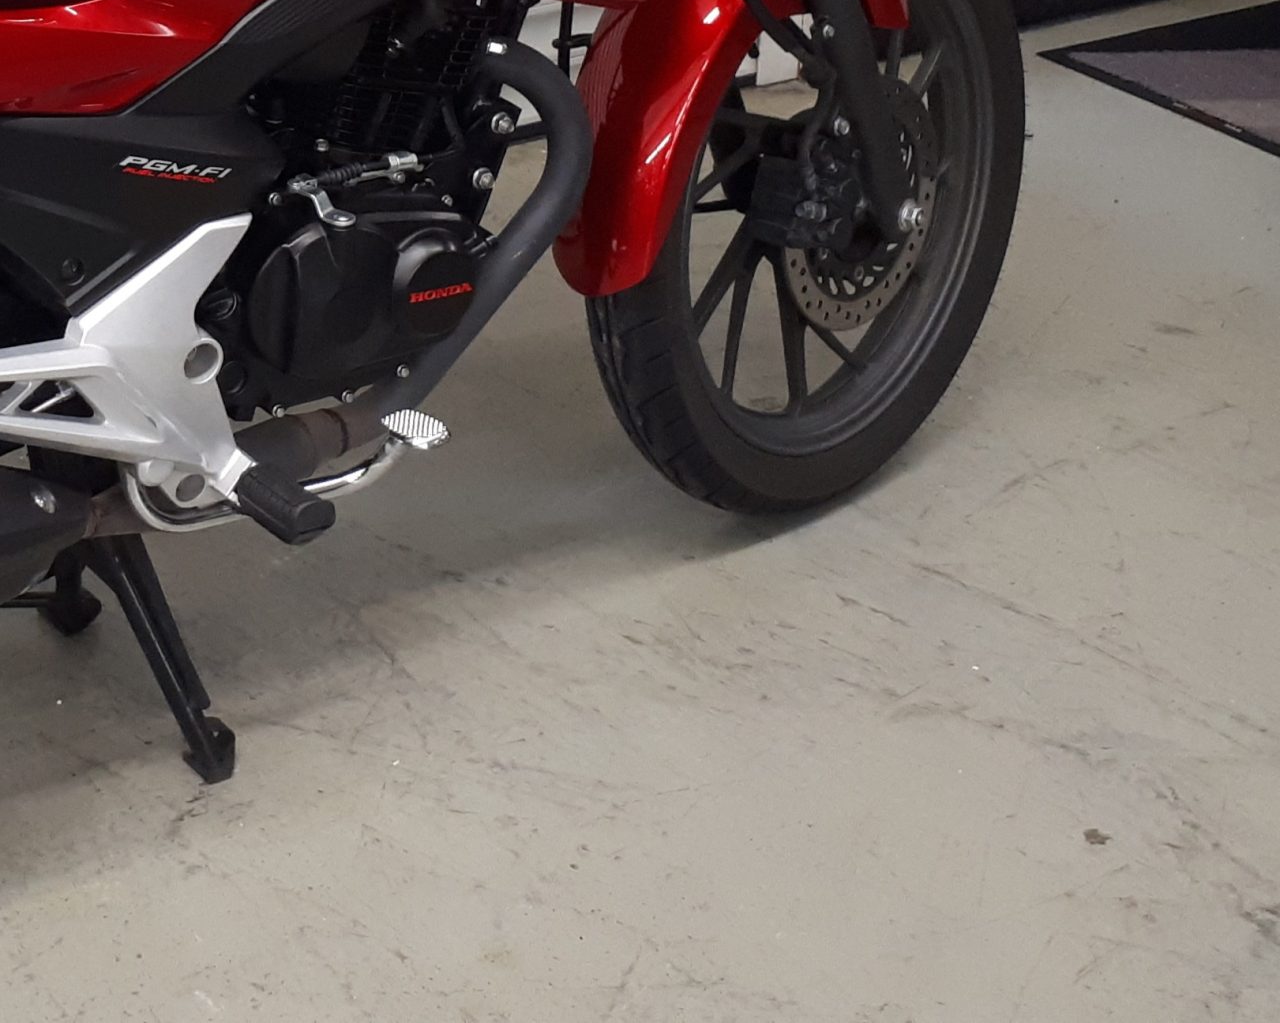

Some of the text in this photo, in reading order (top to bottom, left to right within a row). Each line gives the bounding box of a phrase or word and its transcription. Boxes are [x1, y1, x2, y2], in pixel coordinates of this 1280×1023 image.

[122, 166, 217, 183] FUEL INJECTION
[409, 282, 473, 303] HONDA
